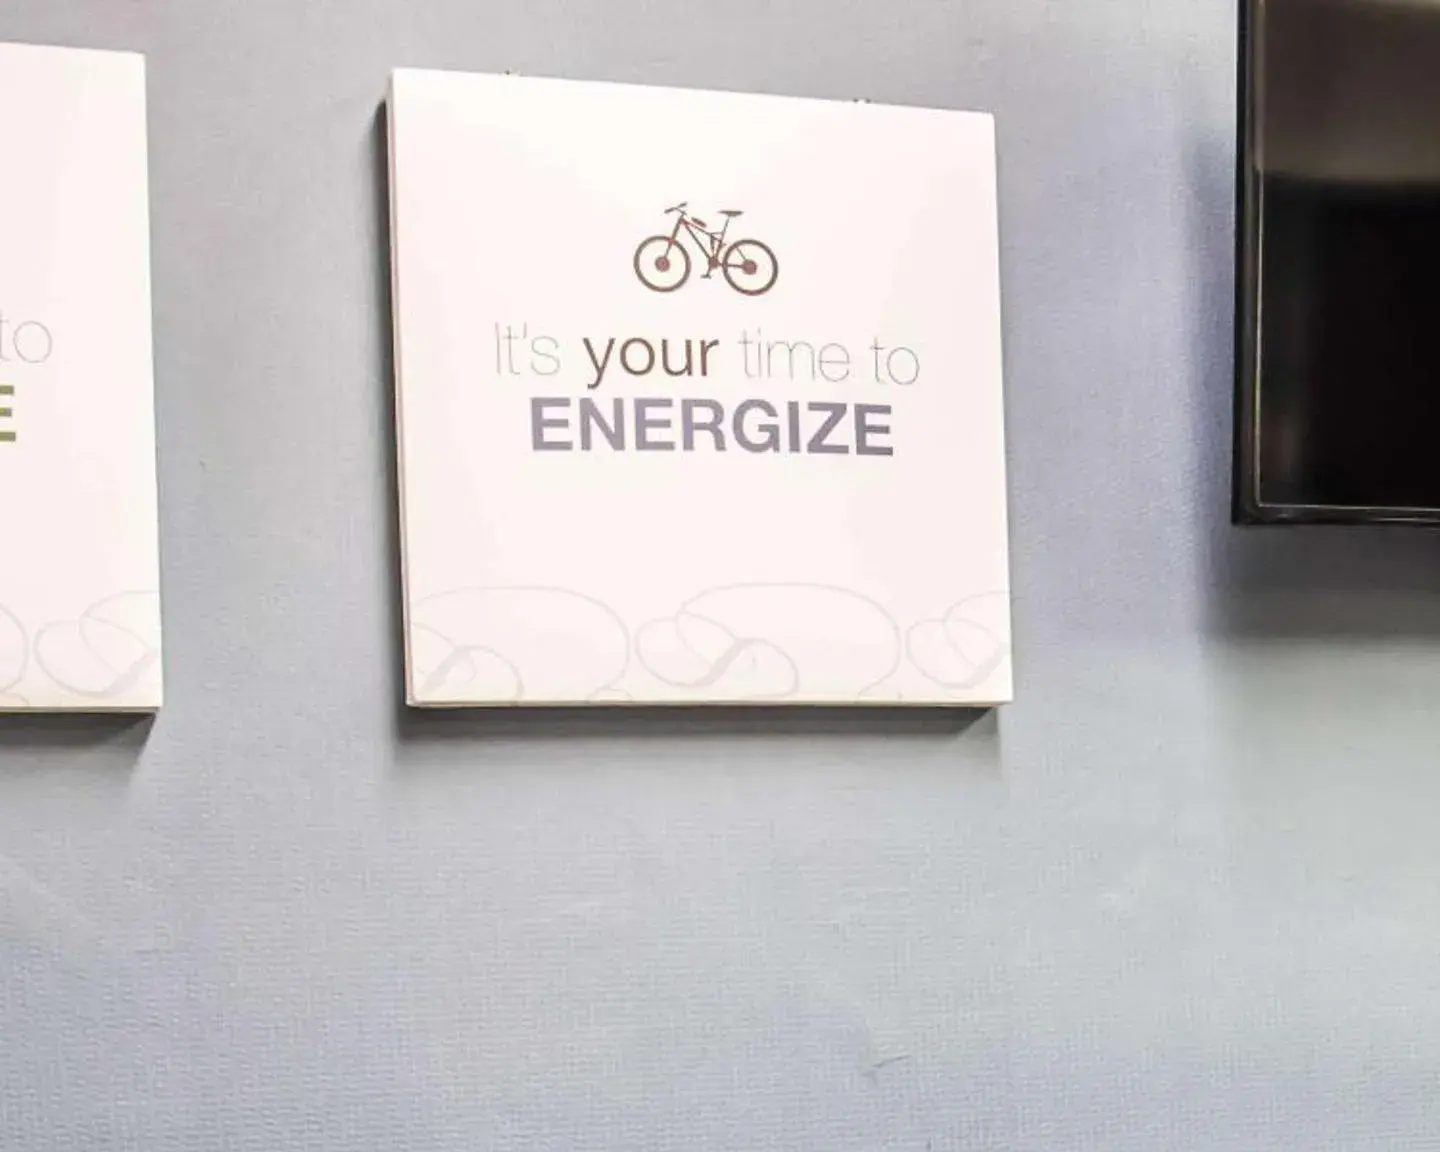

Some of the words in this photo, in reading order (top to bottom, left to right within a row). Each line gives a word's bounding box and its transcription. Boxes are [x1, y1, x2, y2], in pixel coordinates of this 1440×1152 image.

[494, 322, 561, 377] It's
[583, 335, 720, 390] your
[737, 326, 852, 383] time
[869, 336, 921, 387] to
[529, 396, 895, 457] ENERGIZE
